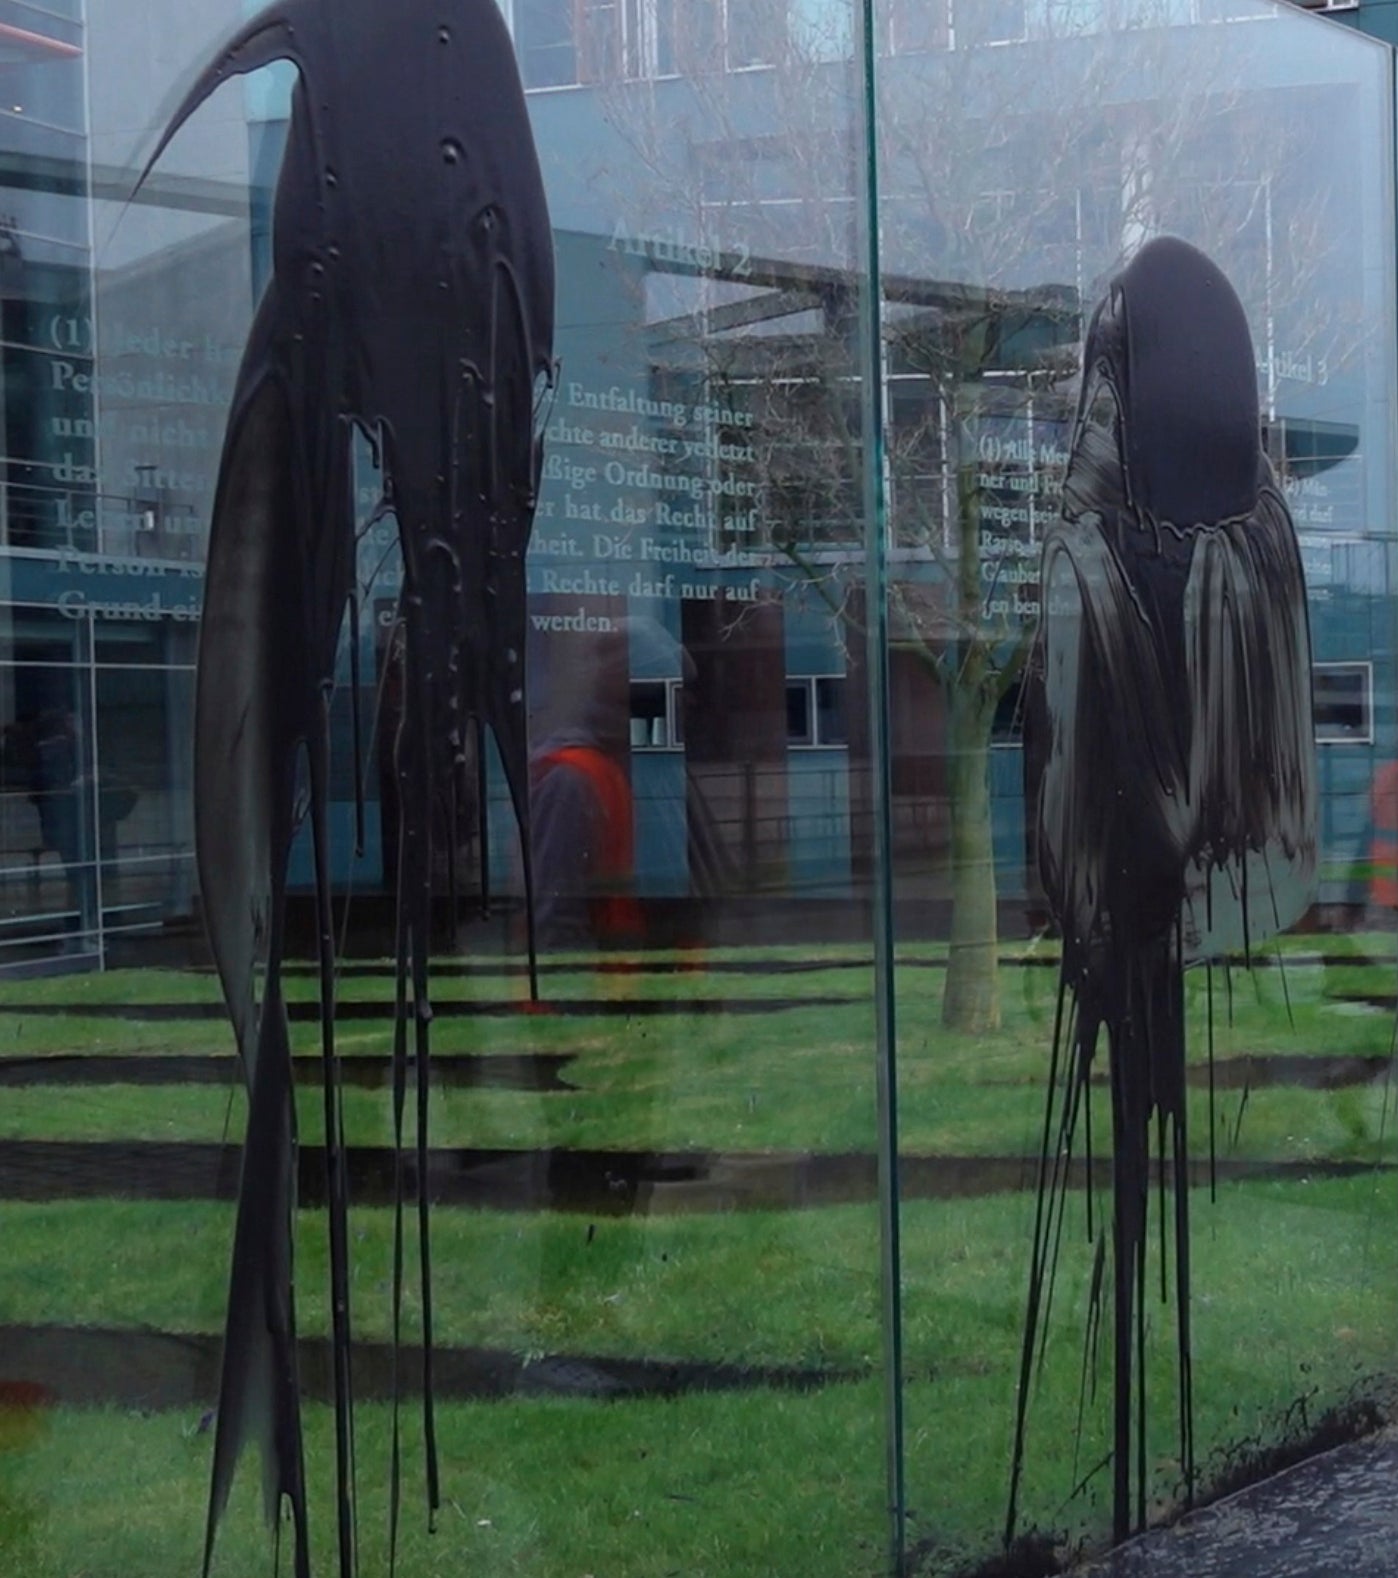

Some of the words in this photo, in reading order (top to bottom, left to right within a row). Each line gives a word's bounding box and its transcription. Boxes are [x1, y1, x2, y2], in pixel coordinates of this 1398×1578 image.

[606, 216, 722, 270] Artikel
[732, 242, 752, 276] 2
[1318, 359, 1329, 386] 3
[567, 382, 685, 426] Entfaltung
[693, 402, 752, 427] seiner
[601, 425, 677, 455] anderer
[605, 461, 703, 498] Ordnung
[711, 472, 754, 497] oder
[565, 494, 605, 521] hat
[611, 498, 646, 524] das
[655, 502, 718, 529] Recht
[723, 508, 758, 531] auf
[980, 505, 1028, 528] wegen
[593, 534, 633, 560] Die
[640, 537, 721, 566] Freiheit
[543, 568, 621, 597] Rechte
[629, 573, 676, 599] darf
[680, 580, 720, 600] nur
[725, 578, 762, 602] auf
[57, 591, 163, 622] Grund
[532, 607, 619, 634] werden.
